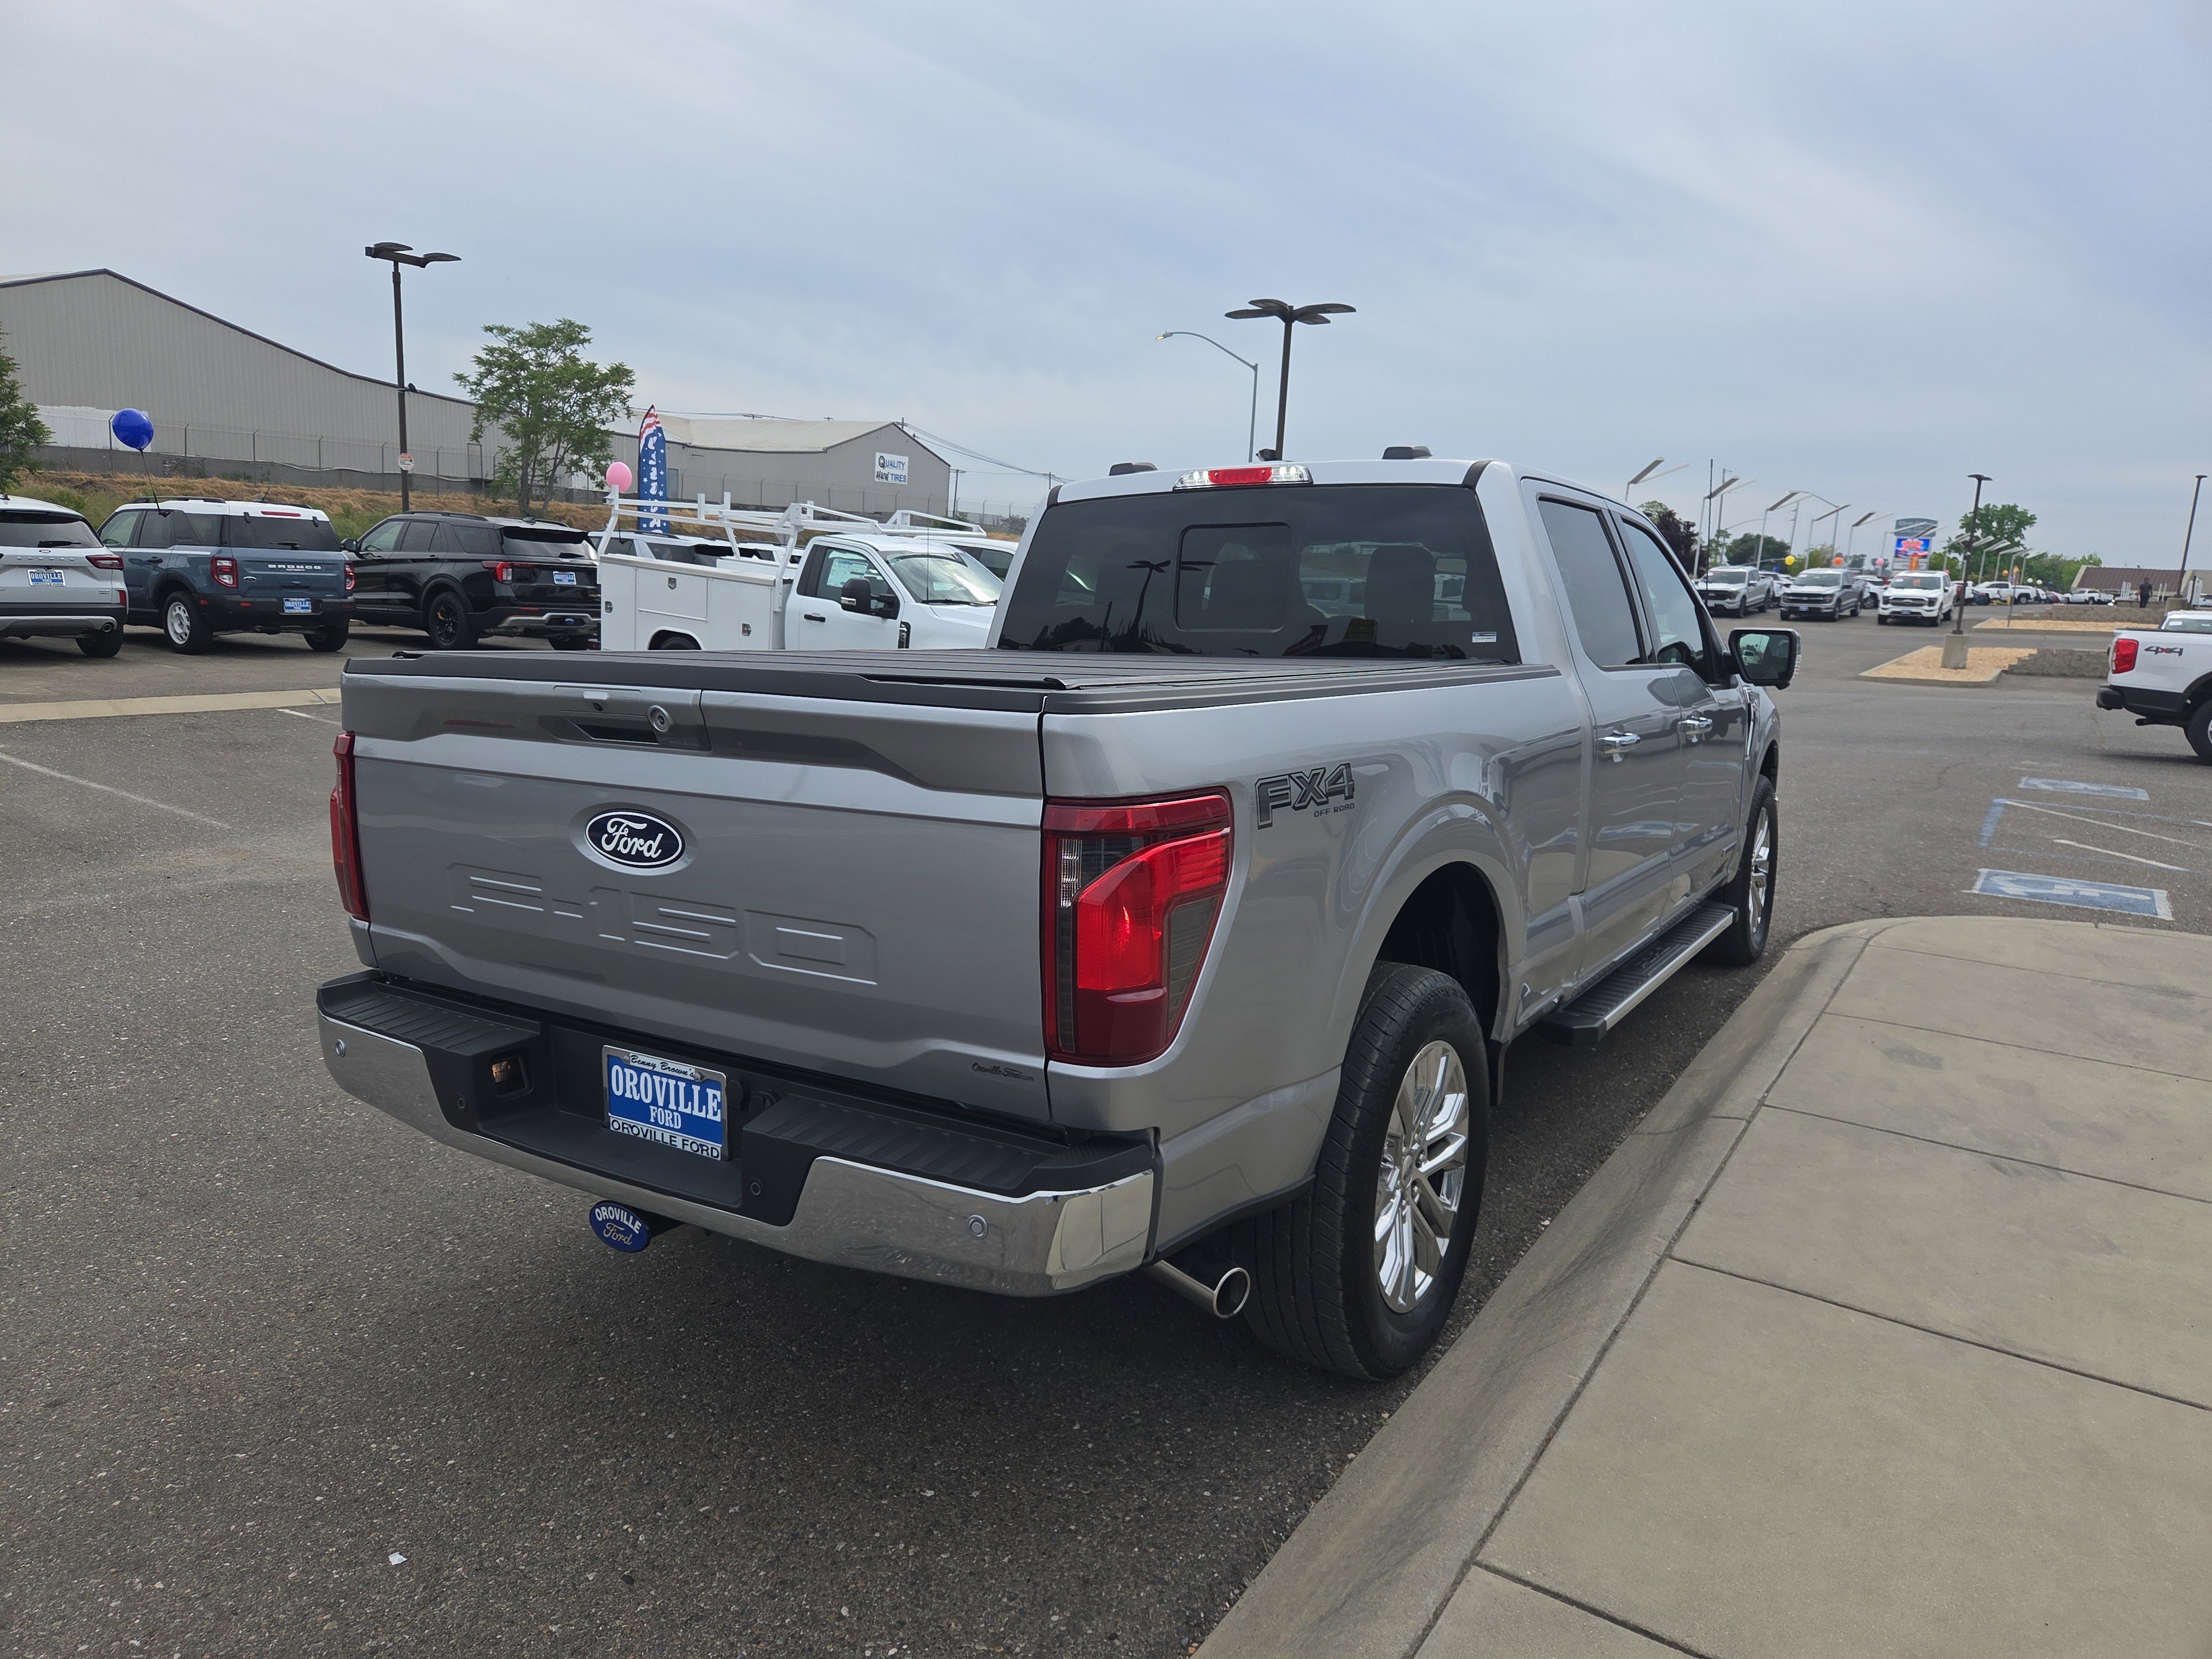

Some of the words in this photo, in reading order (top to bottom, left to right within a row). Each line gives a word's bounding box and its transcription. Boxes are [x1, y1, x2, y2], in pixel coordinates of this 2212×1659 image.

[878, 455, 905, 471] QUALITY
[890, 473, 907, 483] TIRES
[1254, 762, 1355, 830] FX4
[1314, 808, 1331, 818] OFF
[1333, 802, 1355, 813] ROAD
[601, 818, 664, 858] Ford
[447, 861, 878, 985] F-150
[631, 1054, 657, 1071] Benny
[659, 1061, 695, 1080] Brown's
[611, 1065, 721, 1122] OROVILLE
[650, 1105, 681, 1129] FORD
[611, 1119, 678, 1147] OROVILLE
[681, 1137, 719, 1159] FORD
[595, 1206, 642, 1234] OROVILLE
[603, 1222, 633, 1245] Ford
